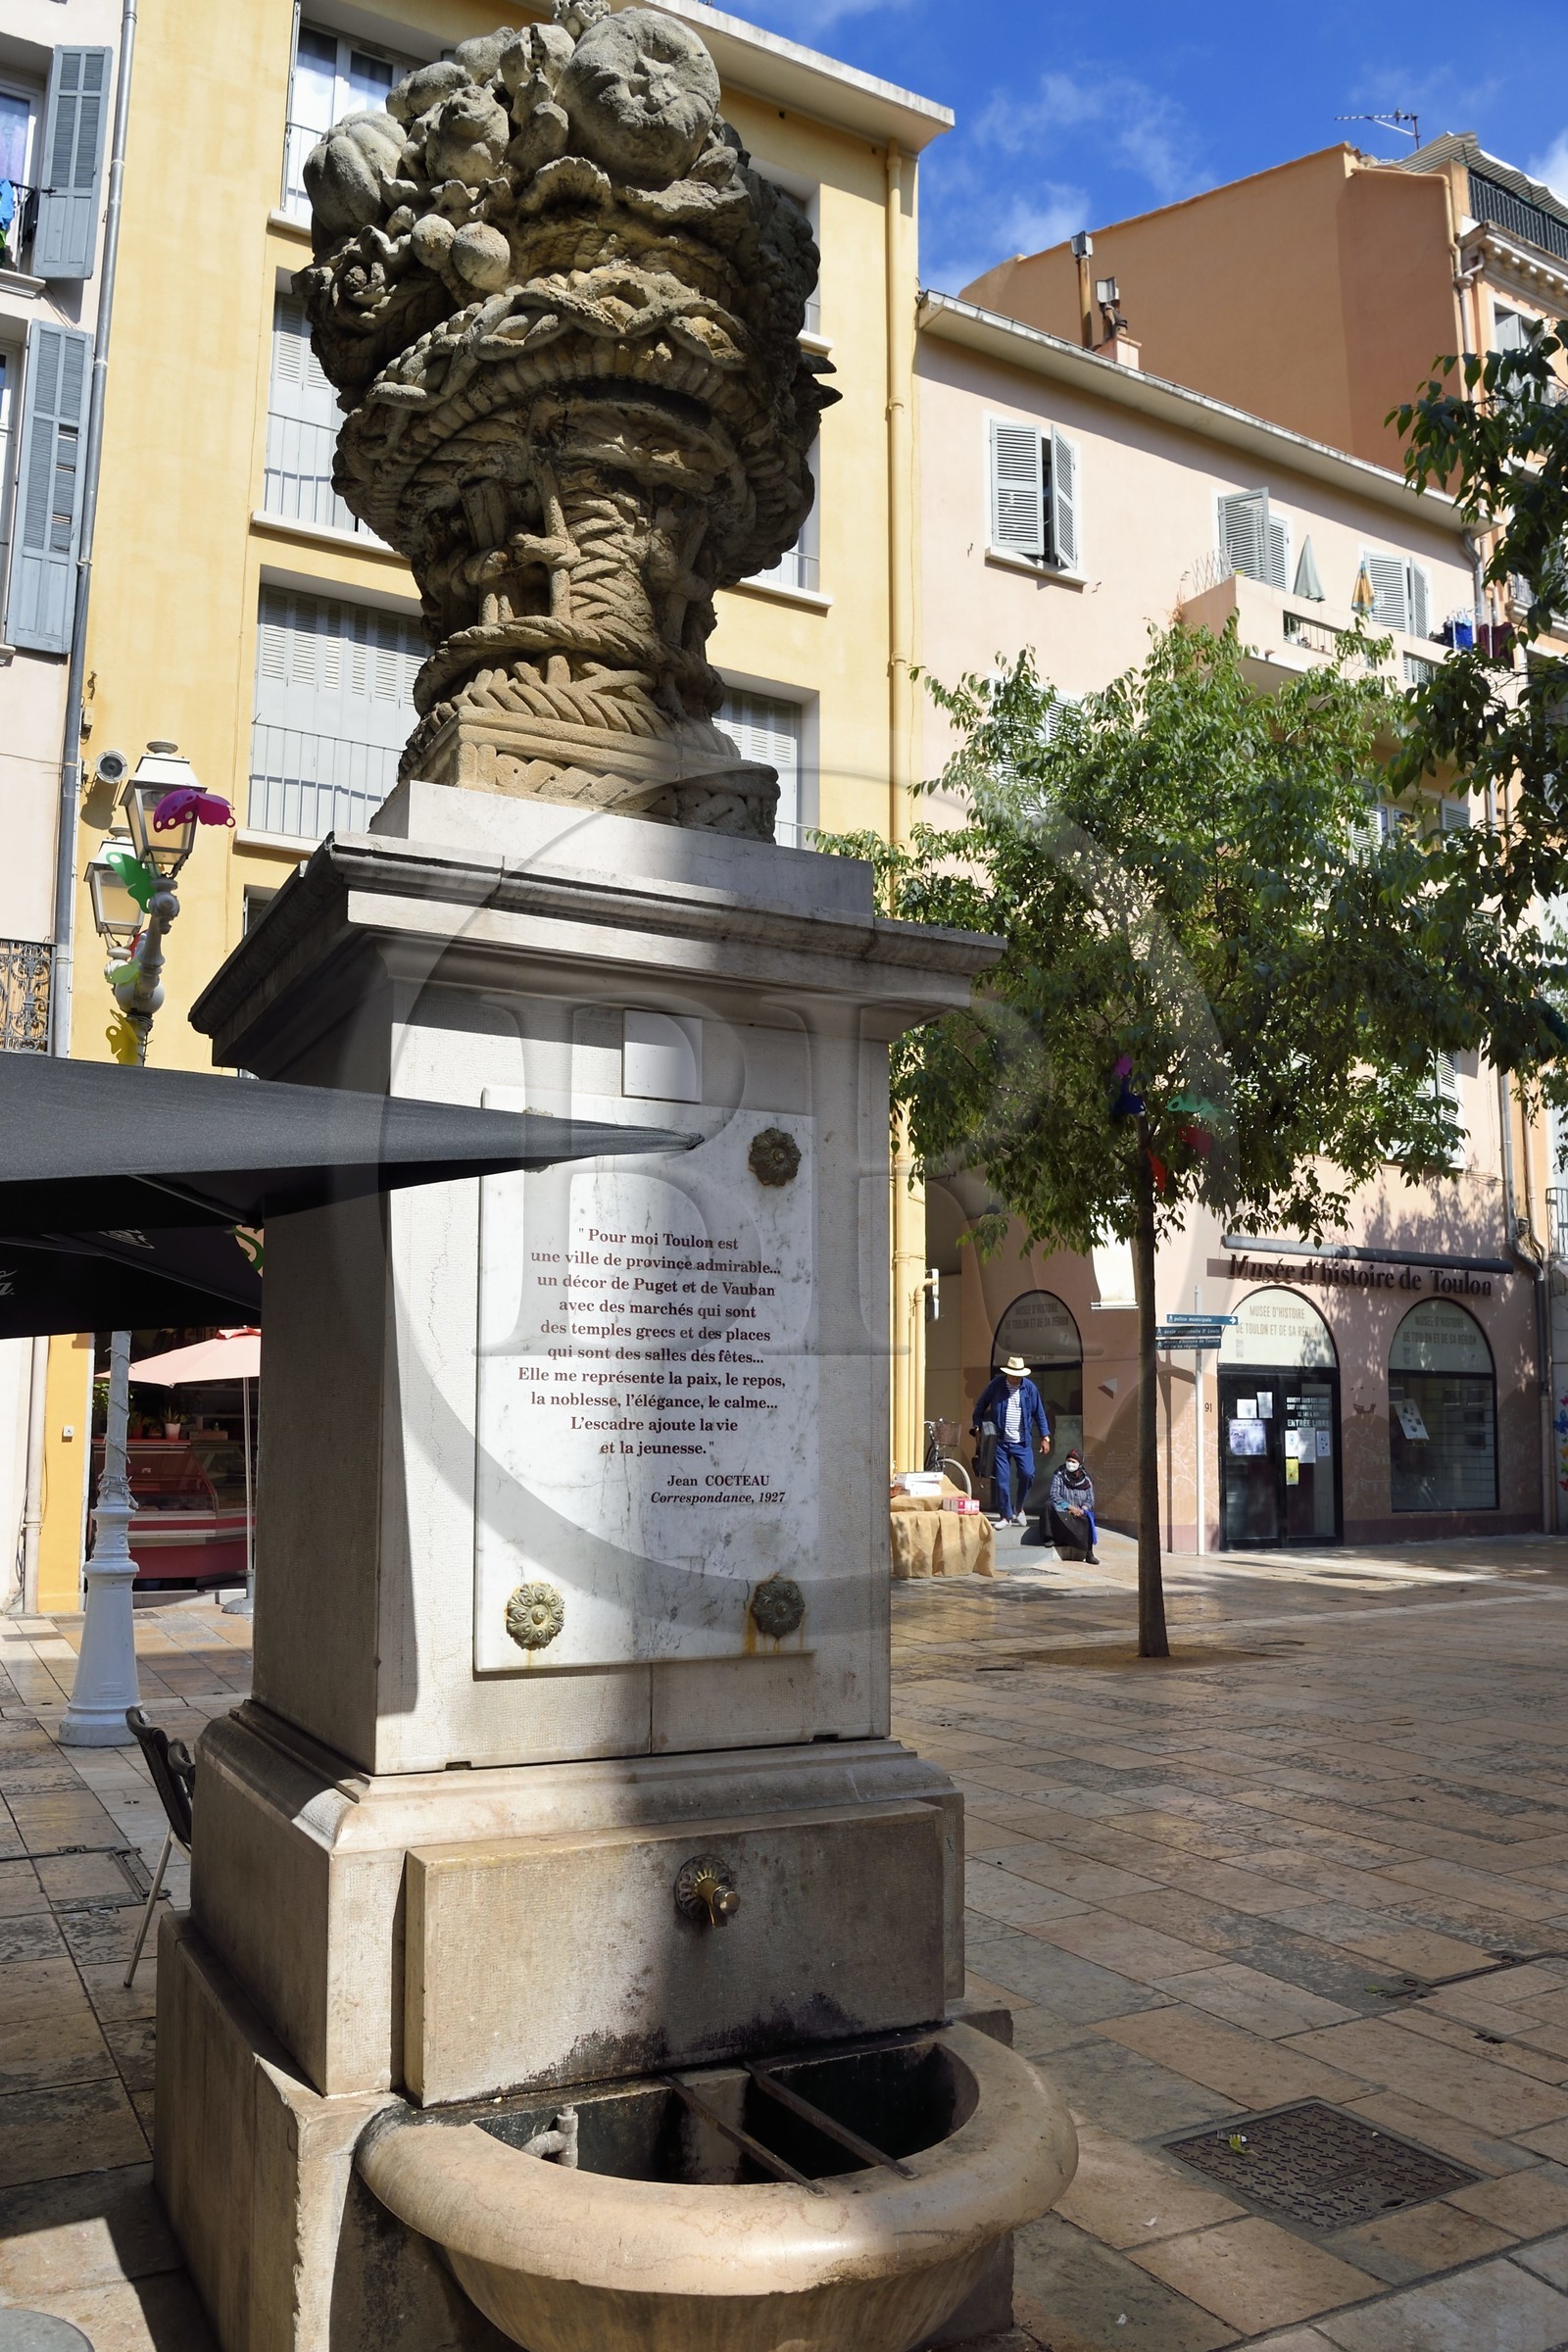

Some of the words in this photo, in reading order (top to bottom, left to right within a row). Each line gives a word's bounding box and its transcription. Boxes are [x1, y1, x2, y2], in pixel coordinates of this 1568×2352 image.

[588, 1229, 626, 1243] Pour
[631, 1233, 659, 1247] moi
[662, 1233, 714, 1249] Toulon
[717, 1239, 738, 1250] est
[530, 1252, 560, 1262] une
[564, 1251, 599, 1265] ville
[604, 1252, 621, 1266] de
[626, 1255, 694, 1272] province
[696, 1257, 782, 1275] admirable...
[1229, 1253, 1296, 1280] Musée
[1398, 1266, 1421, 1290] de
[1430, 1270, 1492, 1296] Toulon
[537, 1277, 558, 1286] un
[563, 1274, 607, 1289] décor
[611, 1275, 629, 1290] de
[632, 1278, 678, 1295] Puget
[682, 1281, 696, 1293] et
[701, 1281, 717, 1294] de
[721, 1282, 775, 1296] Vauban
[560, 1301, 595, 1313] avec
[599, 1299, 625, 1313] des
[628, 1300, 693, 1316] marchés
[698, 1304, 721, 1319] qui
[725, 1306, 757, 1318] sont
[541, 1320, 566, 1334] des
[571, 1323, 631, 1339] temples
[636, 1327, 675, 1341] grecs
[680, 1327, 694, 1339] et
[699, 1326, 721, 1340] des
[725, 1328, 770, 1343] places
[1245, 1323, 1268, 1335] TOULON
[1270, 1325, 1278, 1335] ET
[1289, 1325, 1296, 1337] SA
[548, 1346, 572, 1360] qui
[577, 1348, 612, 1359] sont
[615, 1347, 642, 1360] des
[643, 1348, 686, 1362] salles
[691, 1348, 715, 1362] des
[718, 1349, 765, 1363] fêtes...
[518, 1367, 549, 1381] Elle
[554, 1372, 577, 1382] me
[581, 1370, 664, 1386] représente
[668, 1371, 682, 1385] la
[687, 1374, 721, 1388] paix,
[725, 1372, 738, 1386] le
[742, 1377, 785, 1389] repos,
[531, 1392, 546, 1404] la
[550, 1393, 621, 1408] noblesse,
[626, 1394, 705, 1410] l'élégance,
[709, 1396, 720, 1408] le
[724, 1396, 777, 1410] calme...
[1204, 1402, 1212, 1412] 91
[570, 1415, 644, 1430] L'escadre
[649, 1418, 696, 1434] ajoute
[700, 1418, 714, 1431] la
[716, 1418, 738, 1431] vie
[599, 1443, 615, 1454] et
[619, 1441, 634, 1455] la
[667, 1475, 698, 1487] Jean
[706, 1475, 769, 1486] COCTEAU
[651, 1492, 756, 1504] Correspondance,
[759, 1492, 786, 1503] 1927
